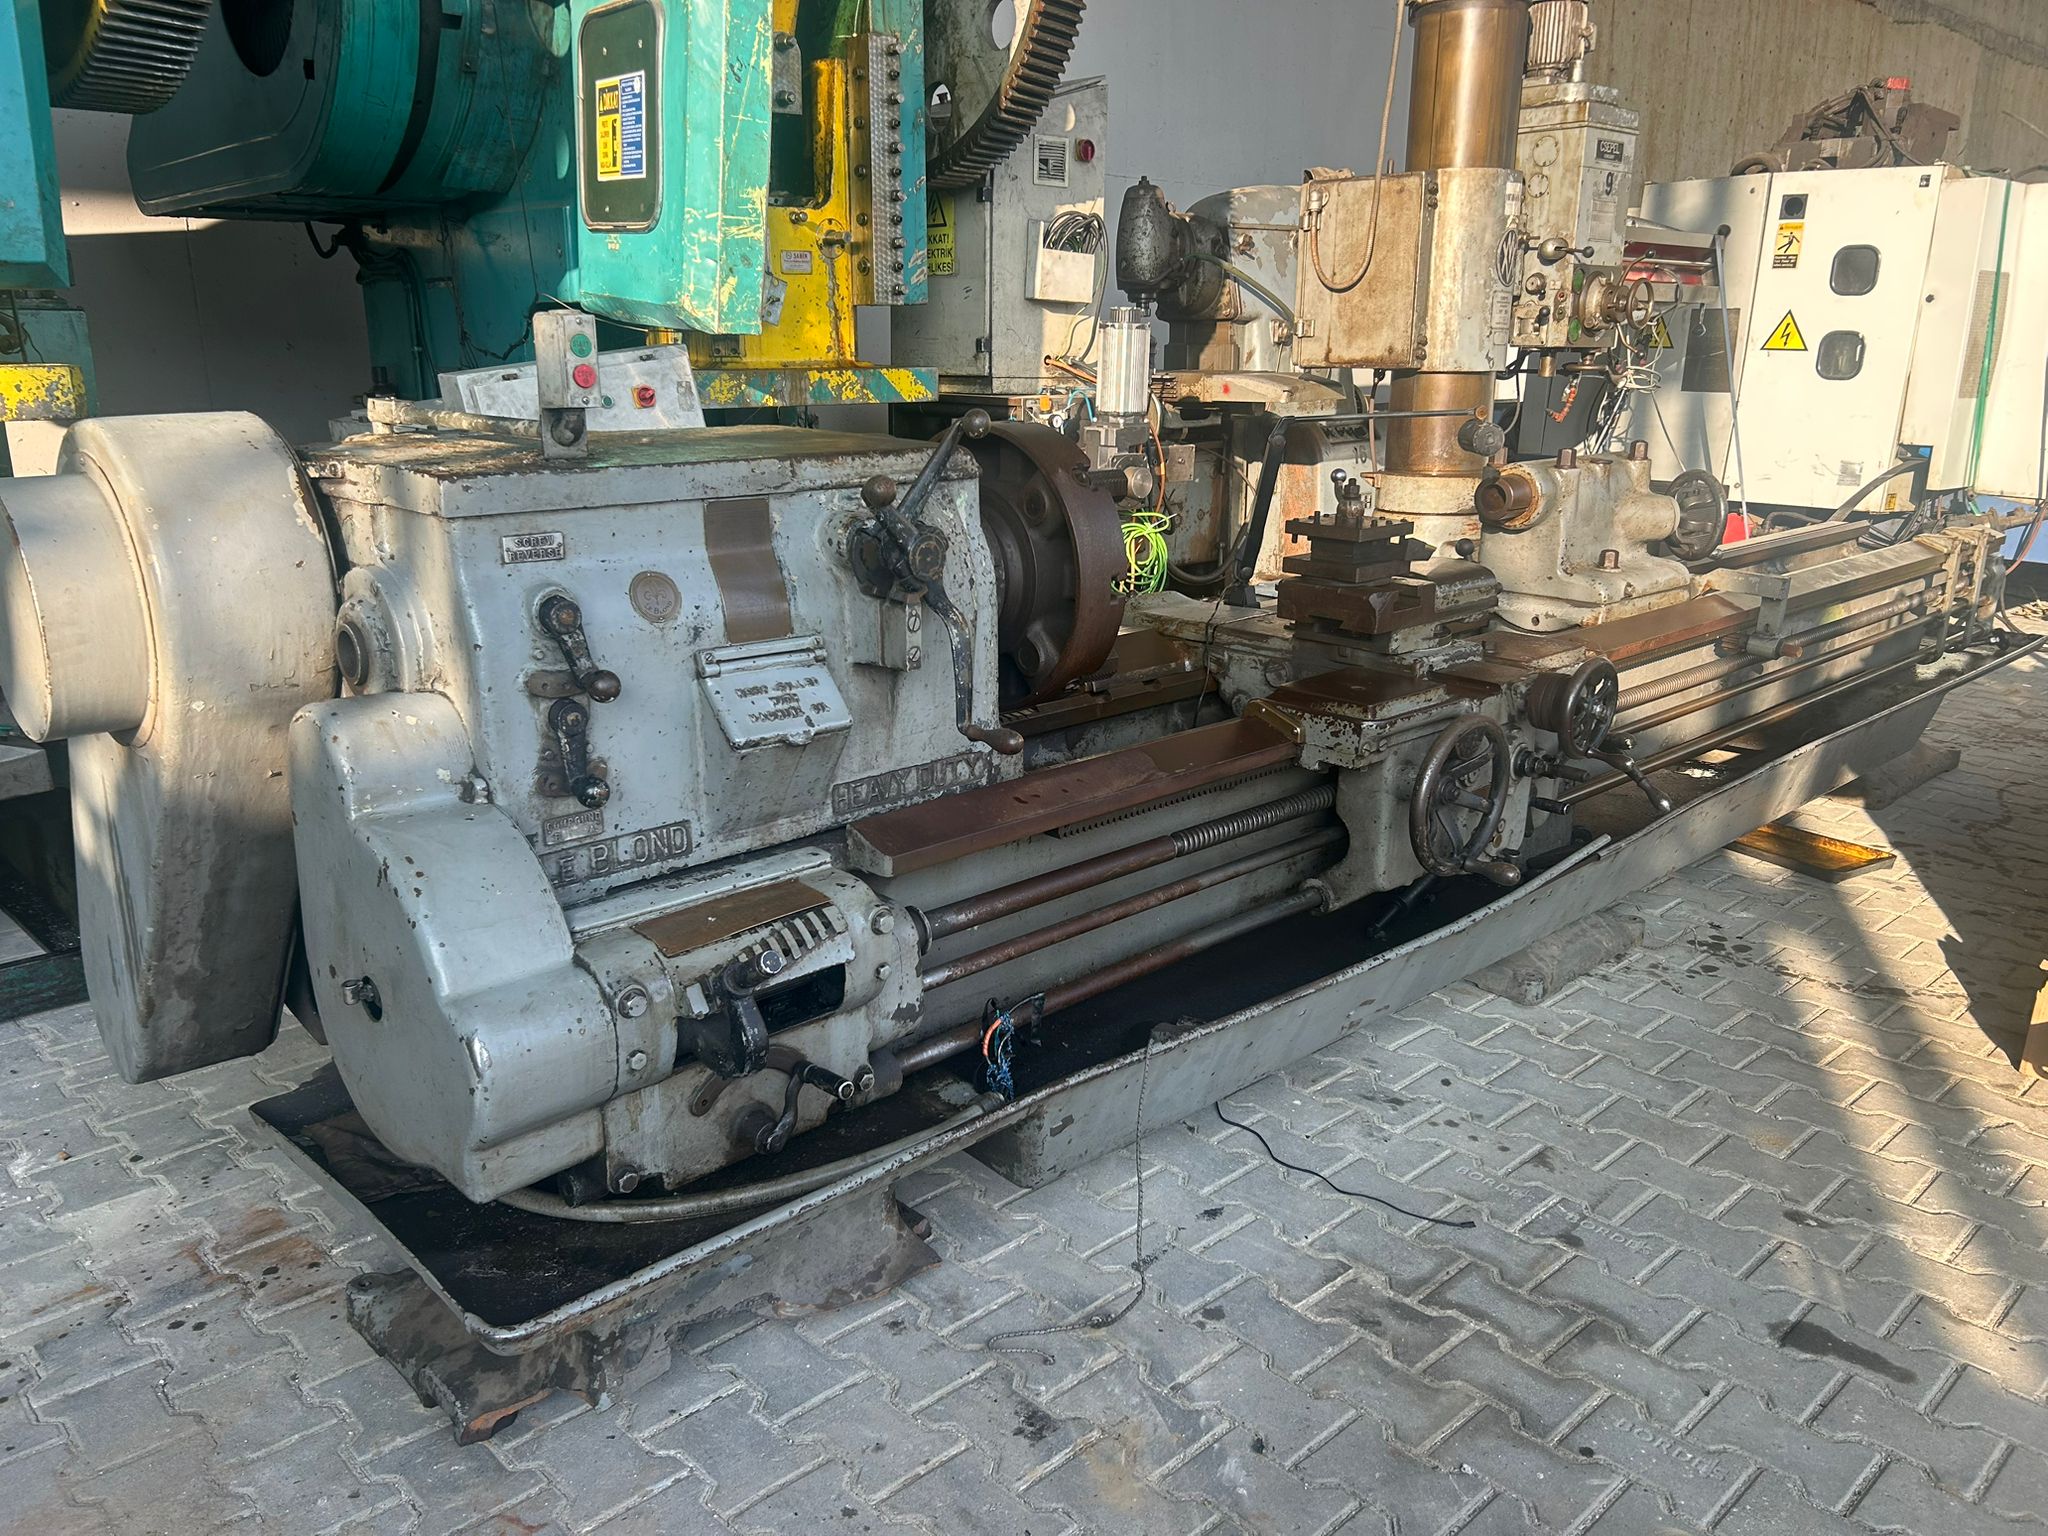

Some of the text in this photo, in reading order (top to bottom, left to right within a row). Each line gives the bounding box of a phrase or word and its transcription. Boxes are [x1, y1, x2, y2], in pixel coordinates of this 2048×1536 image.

[1600, 140, 1620, 154] CSEPEL
[1605, 172, 1614, 196] 9
[514, 535, 555, 548] SCREW
[508, 547, 561, 561] REVERSE
[832, 751, 985, 815] HEAVY DUTY
[589, 825, 688, 875] BLOND
